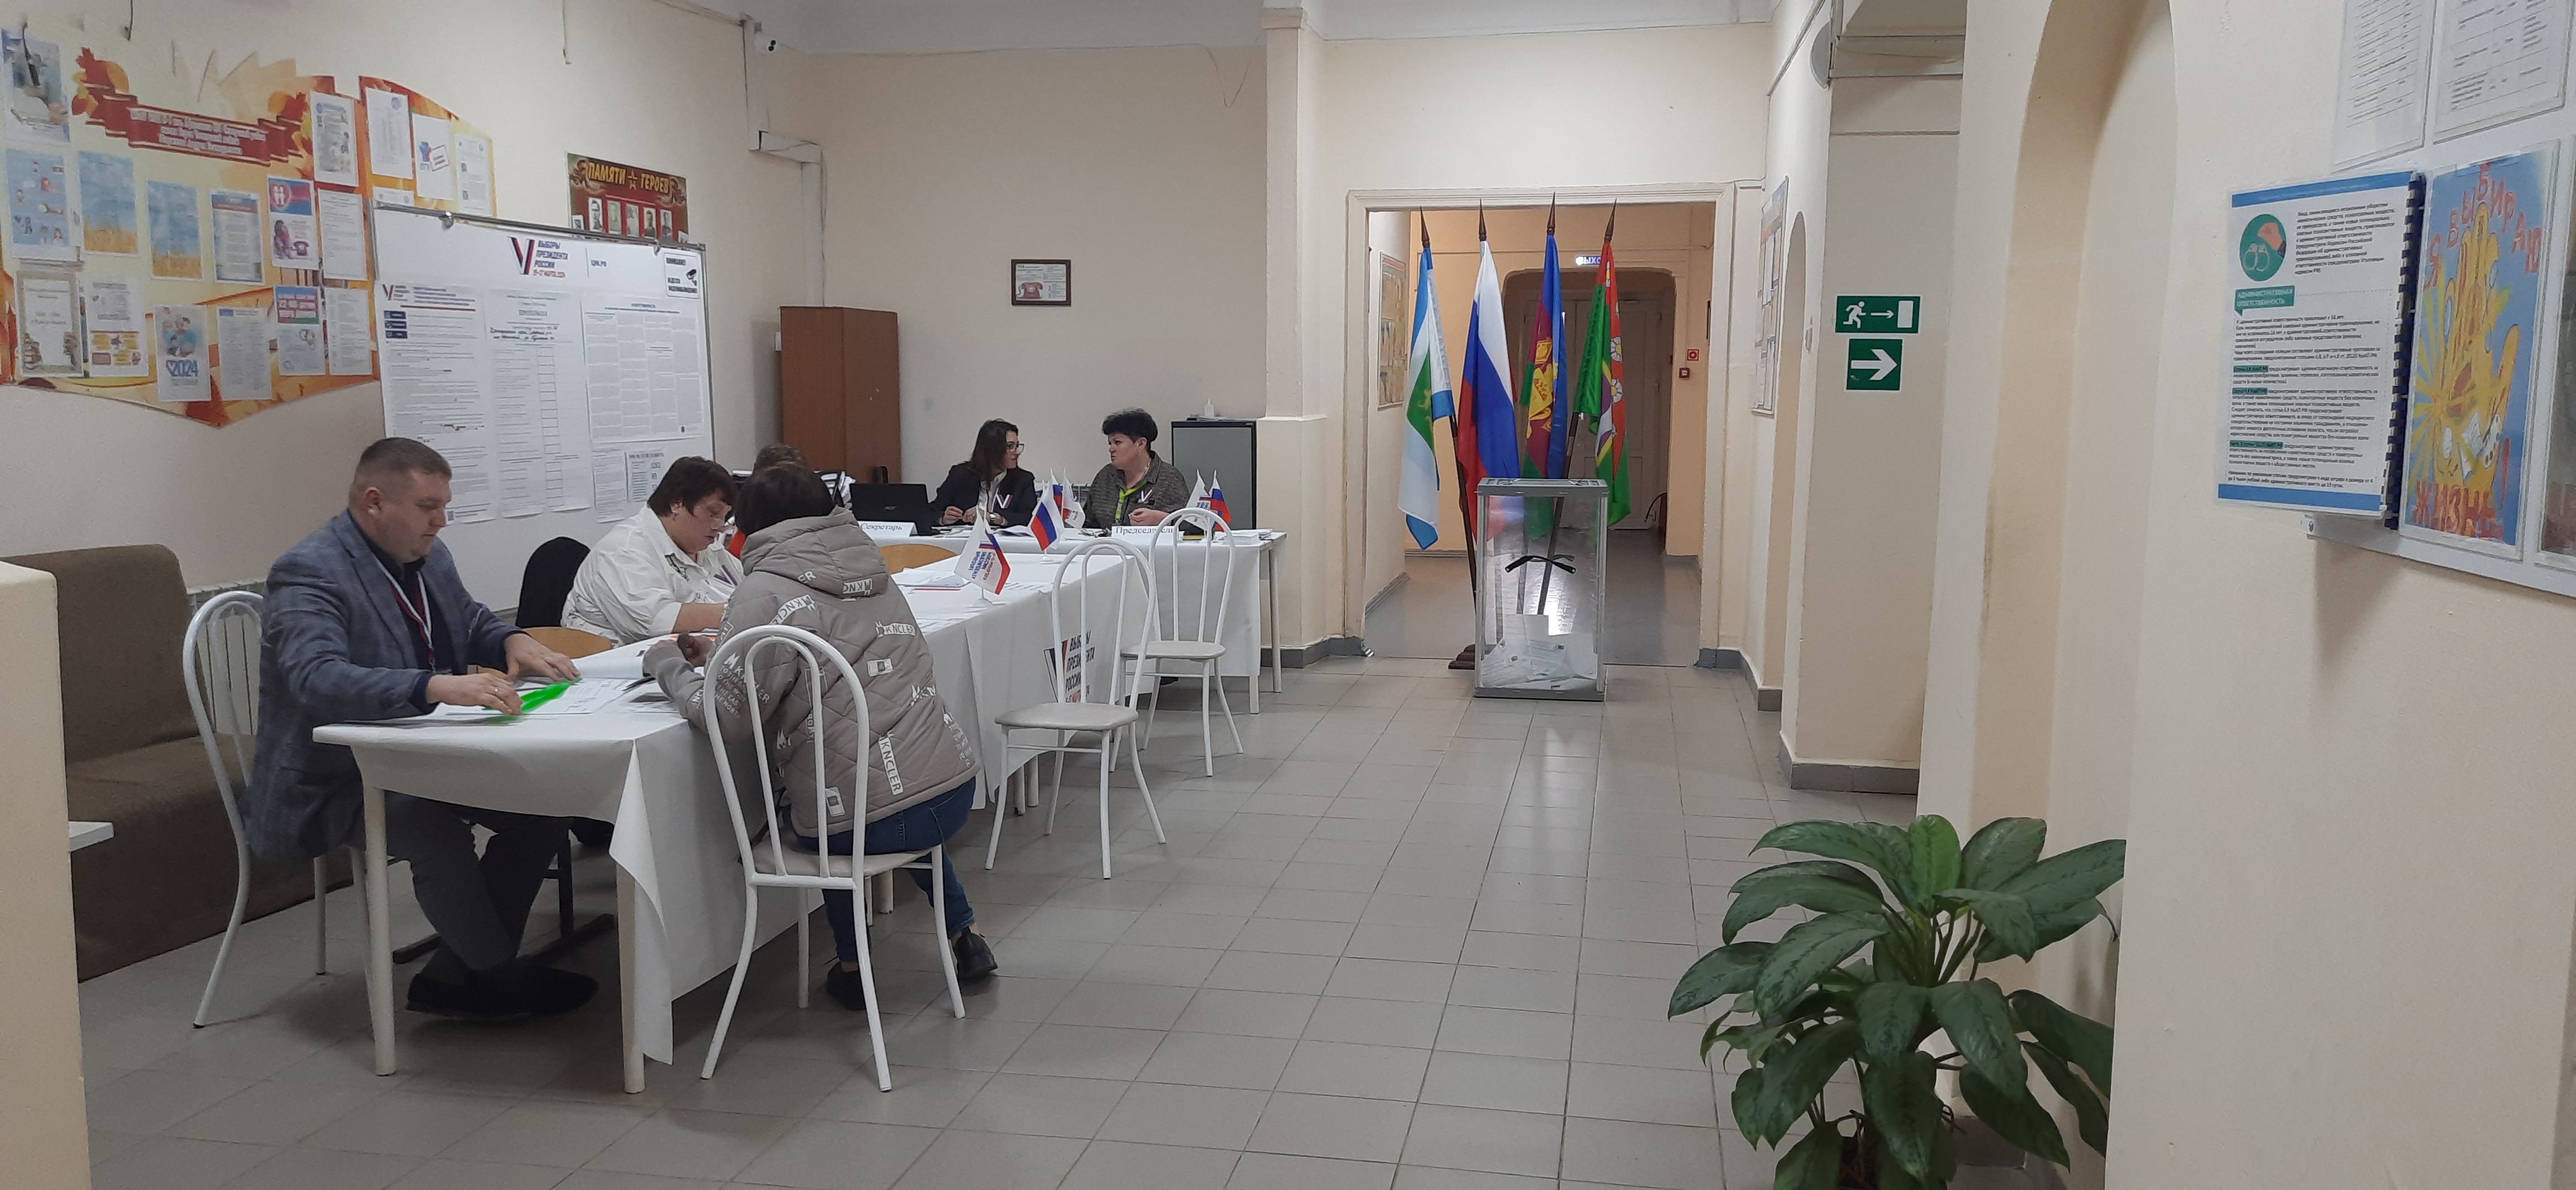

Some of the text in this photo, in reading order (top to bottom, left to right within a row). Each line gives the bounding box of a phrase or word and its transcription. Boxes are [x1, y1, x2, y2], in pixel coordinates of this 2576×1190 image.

[587, 162, 670, 194] ПАМЯТИ ГЕРОЕВ
[1576, 256, 1602, 265] ЫХО
[2424, 233, 2441, 288] Я
